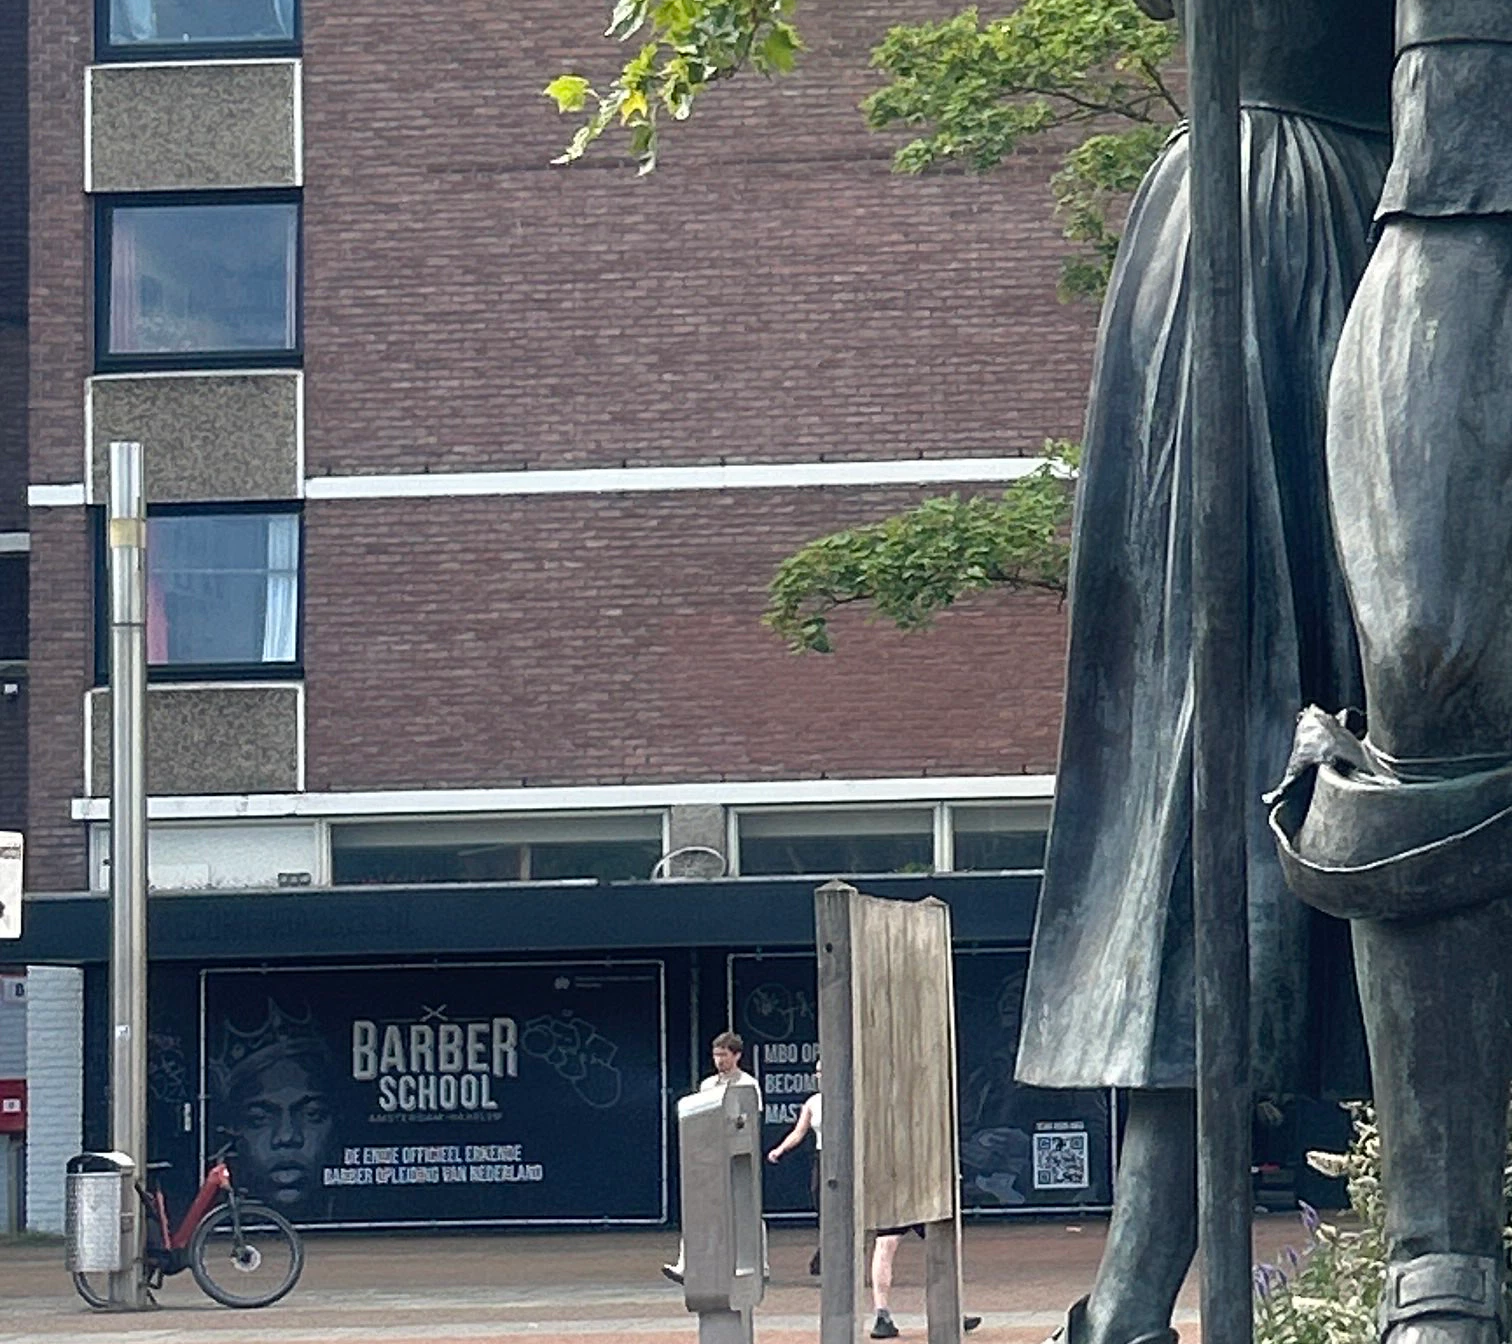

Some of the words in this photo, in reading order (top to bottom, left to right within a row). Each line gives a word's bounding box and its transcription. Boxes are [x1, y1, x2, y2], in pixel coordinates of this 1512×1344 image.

[353, 1017, 518, 1080] BARBER
[764, 1043, 798, 1063] MBO
[379, 1074, 498, 1111] SCHOOL
